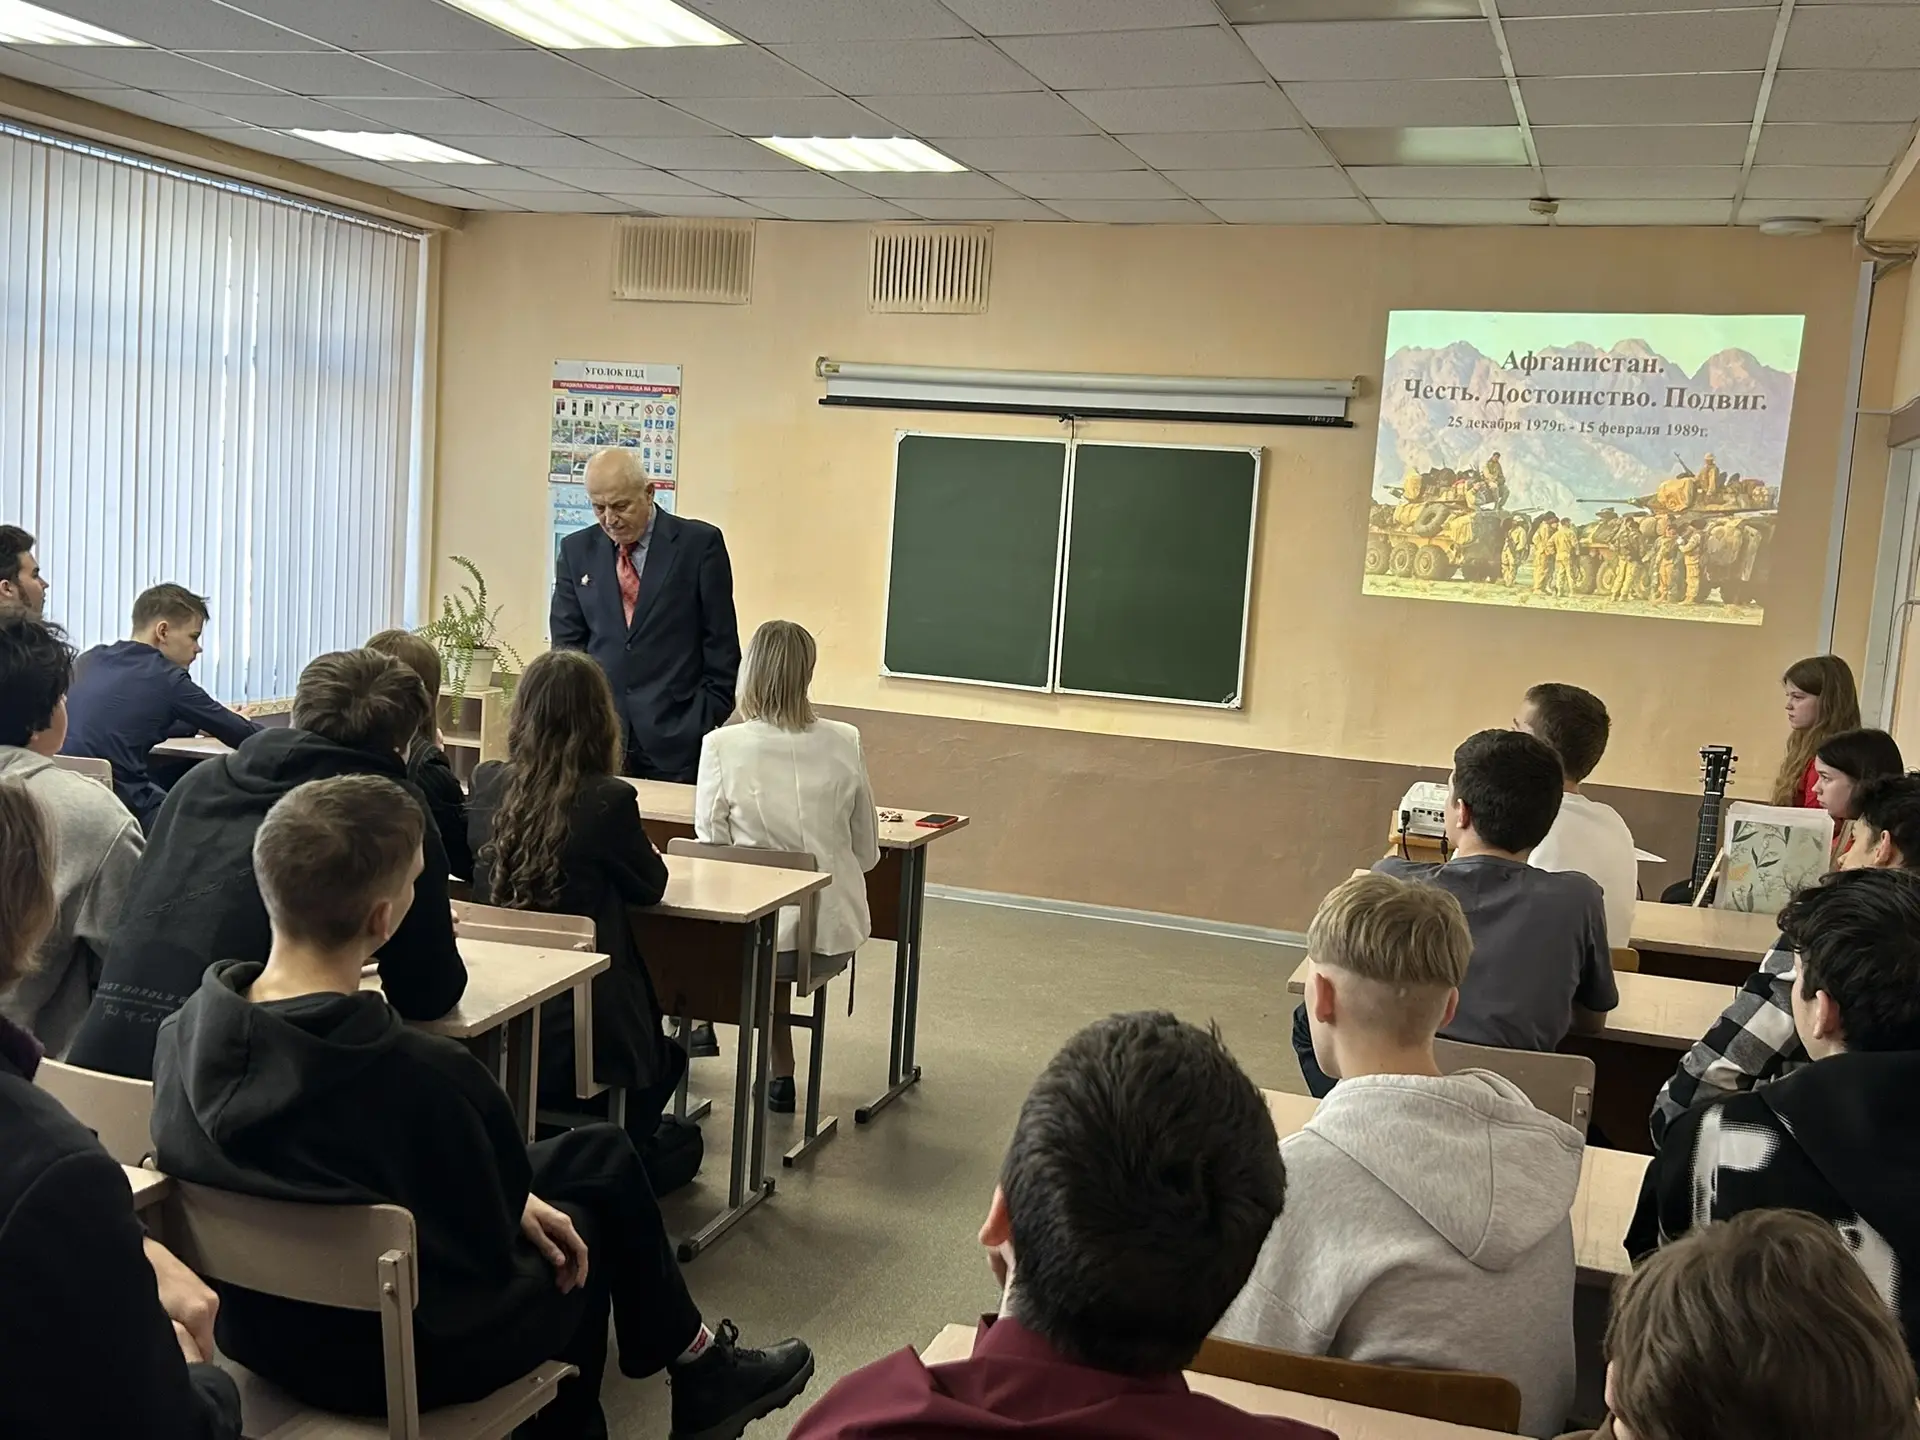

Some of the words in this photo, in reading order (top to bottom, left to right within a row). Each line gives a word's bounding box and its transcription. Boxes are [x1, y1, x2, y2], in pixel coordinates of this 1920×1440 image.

[585, 366, 624, 377] УГОЛОК
[625, 369, 644, 379] ПДД
[1500, 350, 1665, 375] Афганистан.
[1404, 378, 1481, 402] Честь.
[1486, 382, 1657, 409] Достоинство.
[1664, 387, 1768, 412] Подвиг.
[1447, 416, 1463, 429] 25
[1465, 417, 1521, 432] декабря
[1527, 419, 1566, 432] 1979г.
[1579, 421, 1595, 434] 15
[1598, 421, 1660, 437] февраля
[1666, 423, 1708, 437] 1989г.
